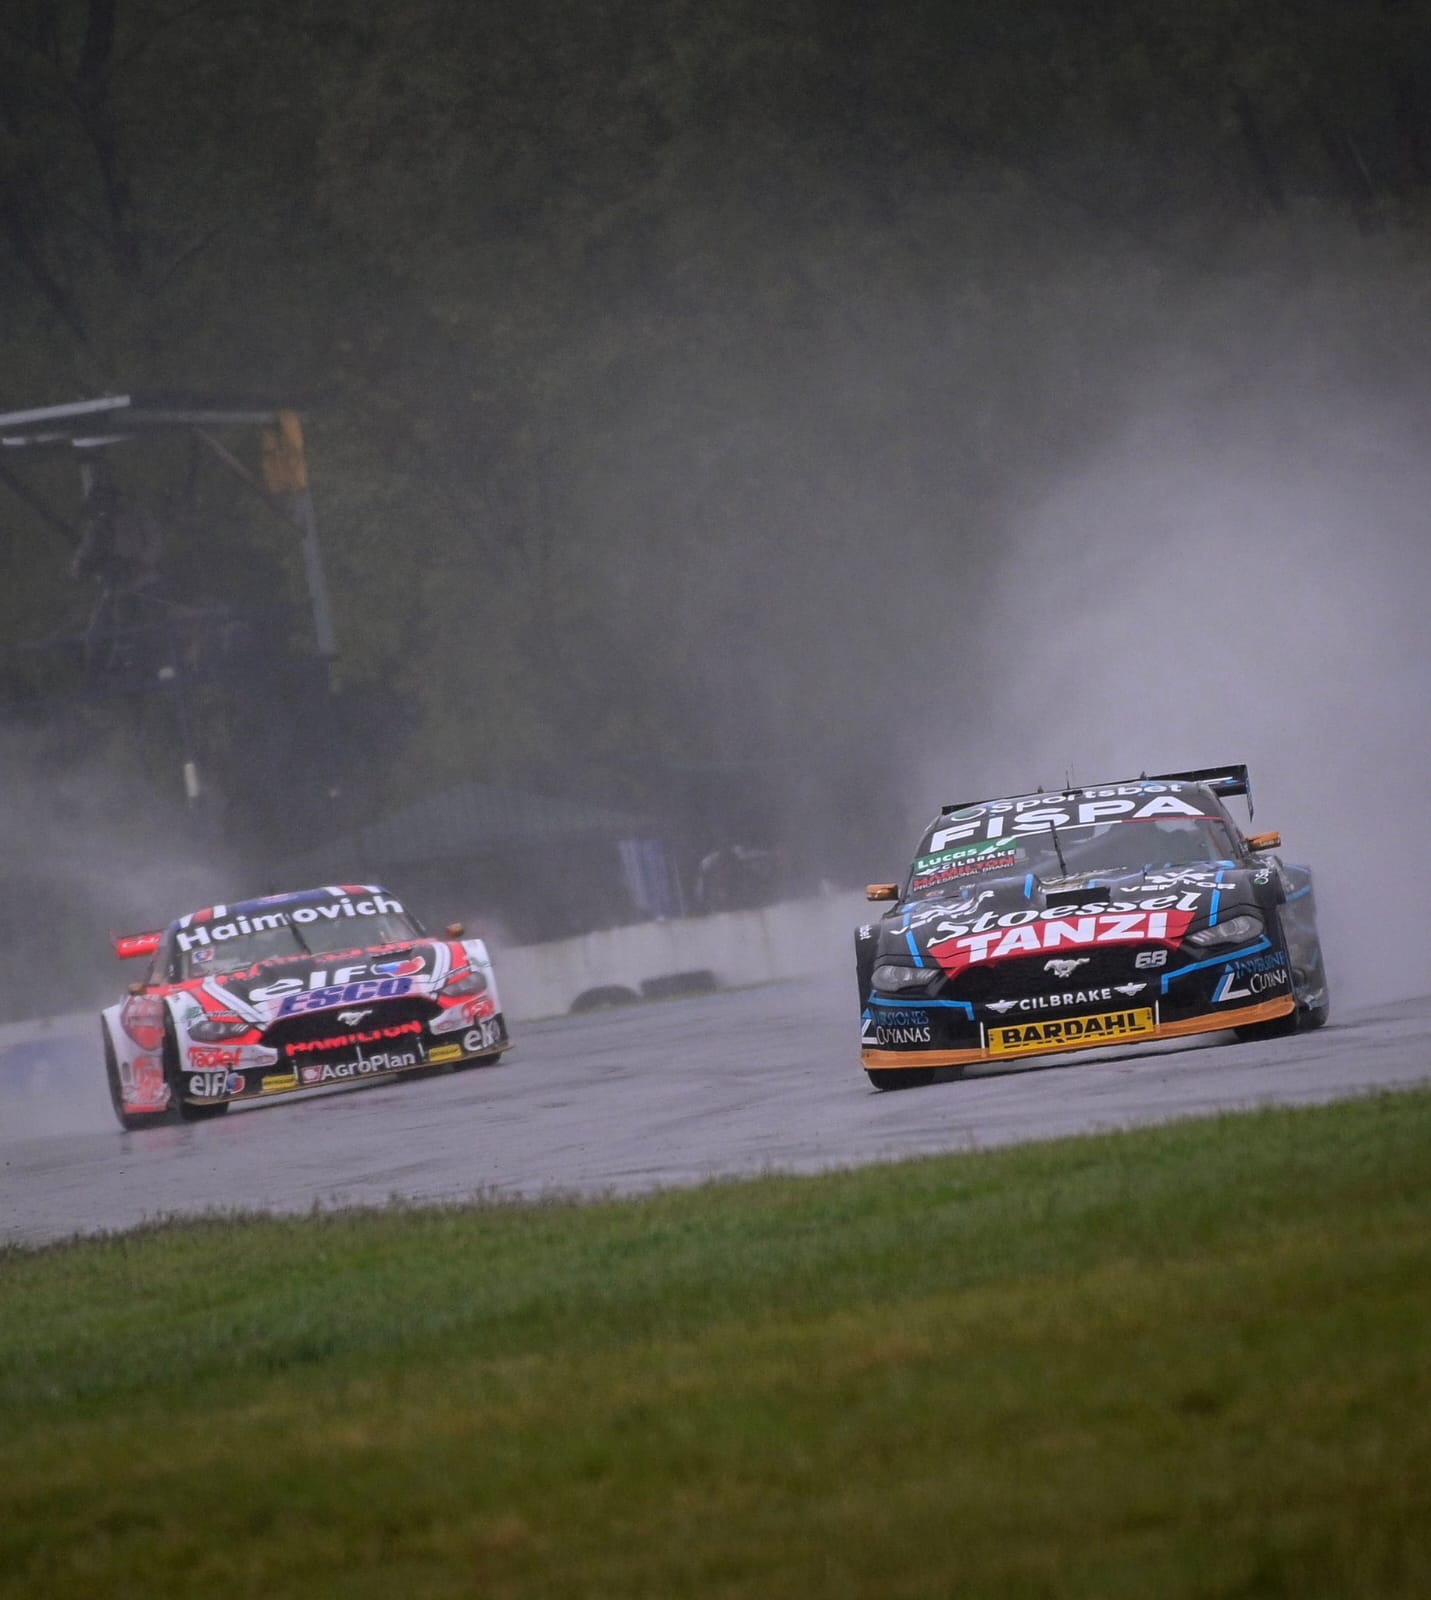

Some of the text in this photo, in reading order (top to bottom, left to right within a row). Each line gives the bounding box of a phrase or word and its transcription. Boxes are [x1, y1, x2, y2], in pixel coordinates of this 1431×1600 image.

[929, 795, 1206, 853] FISPA
[942, 849, 1016, 870] CILBRAKE
[176, 895, 405, 952] Haimovich
[926, 891, 1202, 948] Stoessel
[956, 911, 1169, 964] TANZI
[277, 977, 413, 1018] ESCO
[1019, 986, 1112, 1012] CILBRAKE
[1001, 1011, 1147, 1050] BARDAHL
[321, 1053, 417, 1081] AgroPlan
